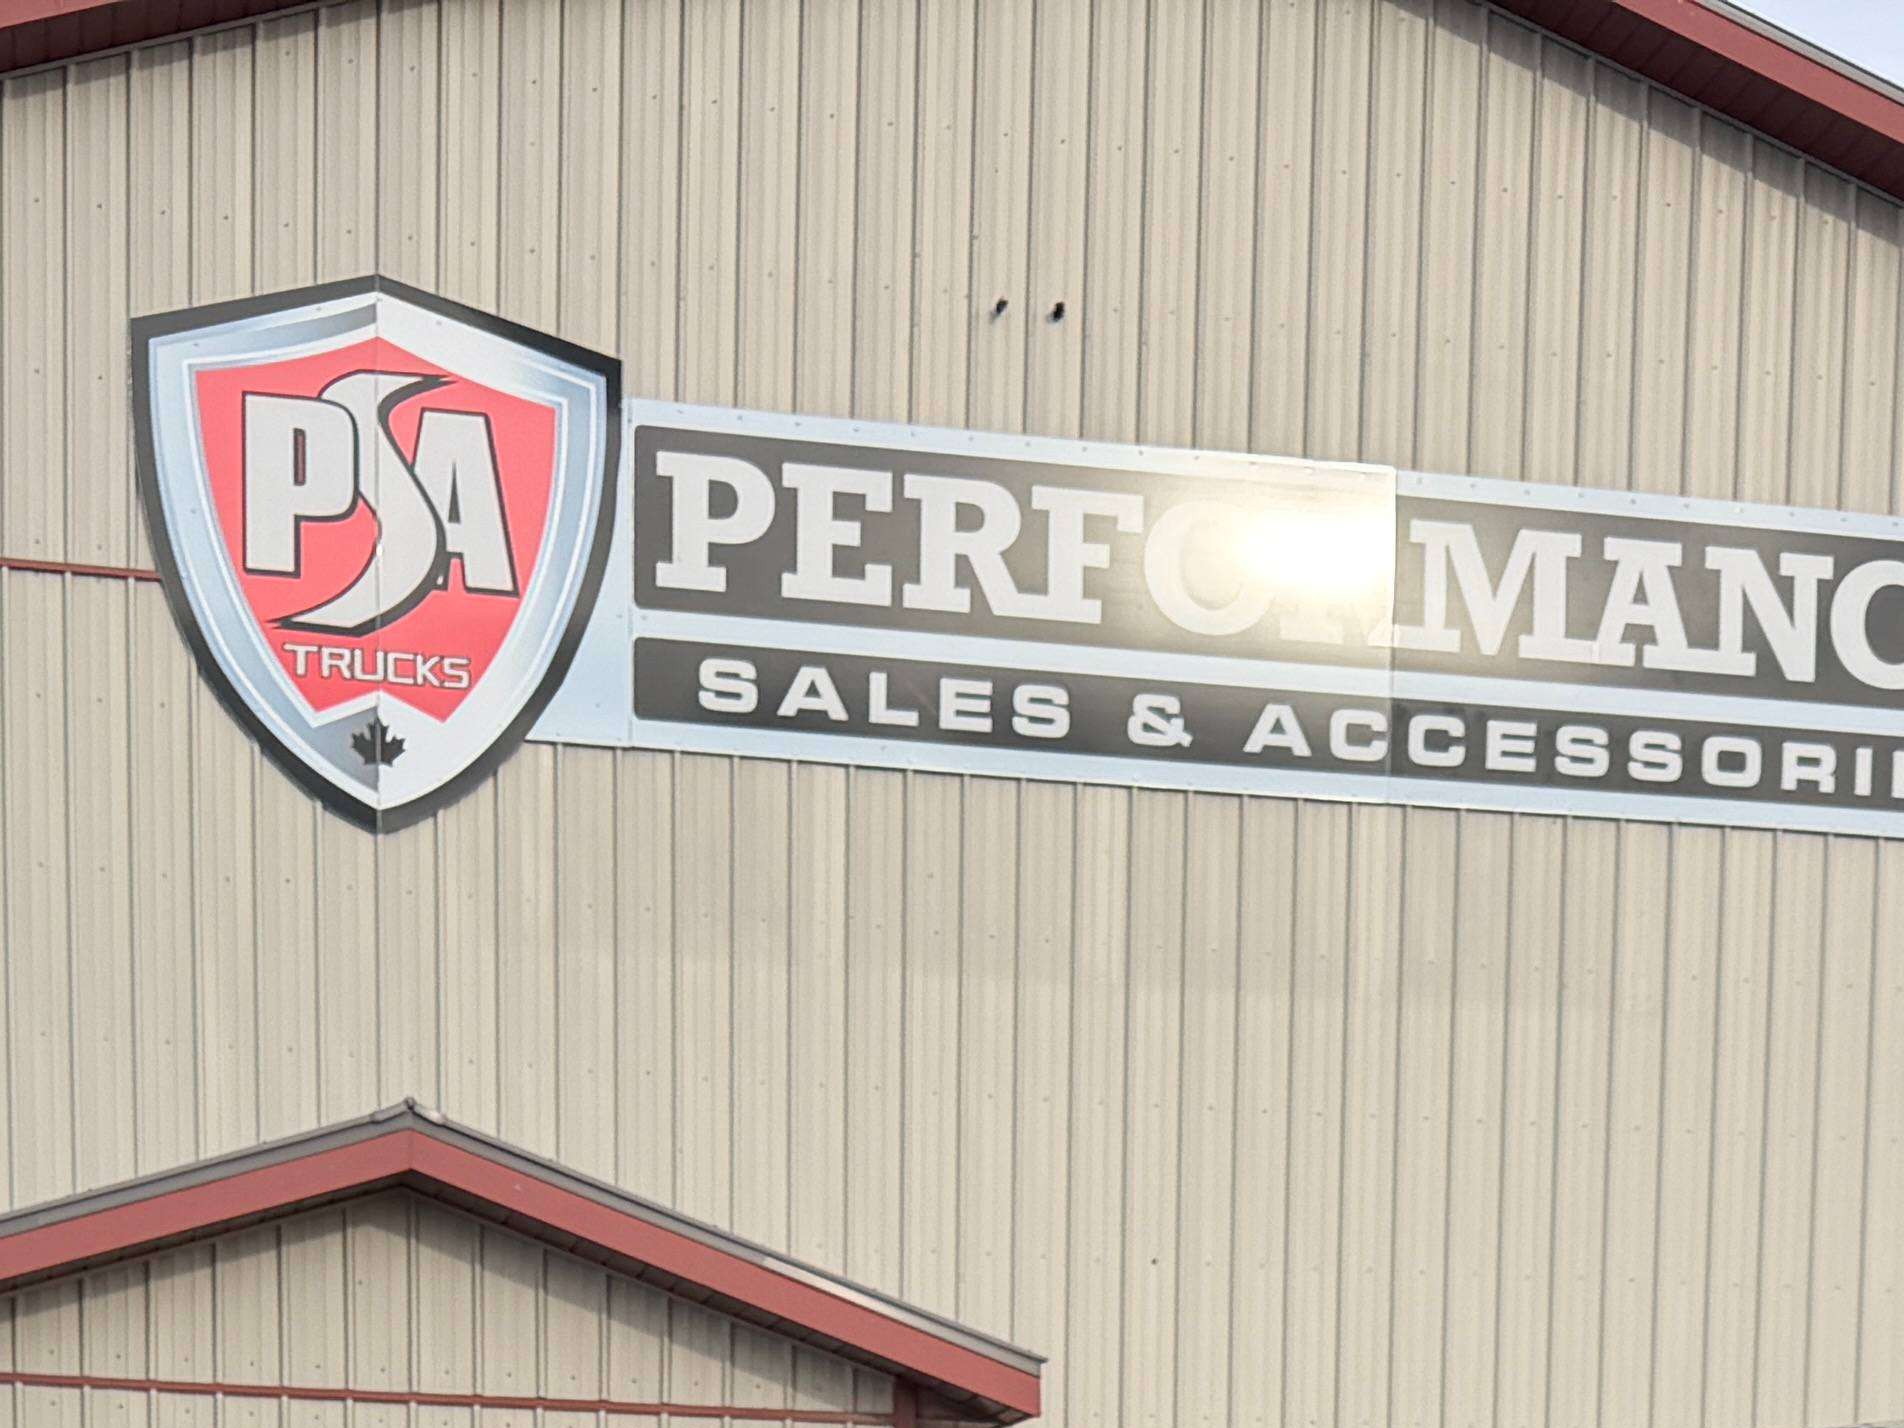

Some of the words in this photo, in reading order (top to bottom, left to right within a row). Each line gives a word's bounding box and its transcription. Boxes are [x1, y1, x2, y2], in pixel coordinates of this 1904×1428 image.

[240, 368, 522, 636] PSA
[282, 641, 474, 691] TRUCKS
[698, 658, 1071, 740] SALES
[1127, 693, 1192, 748] &
